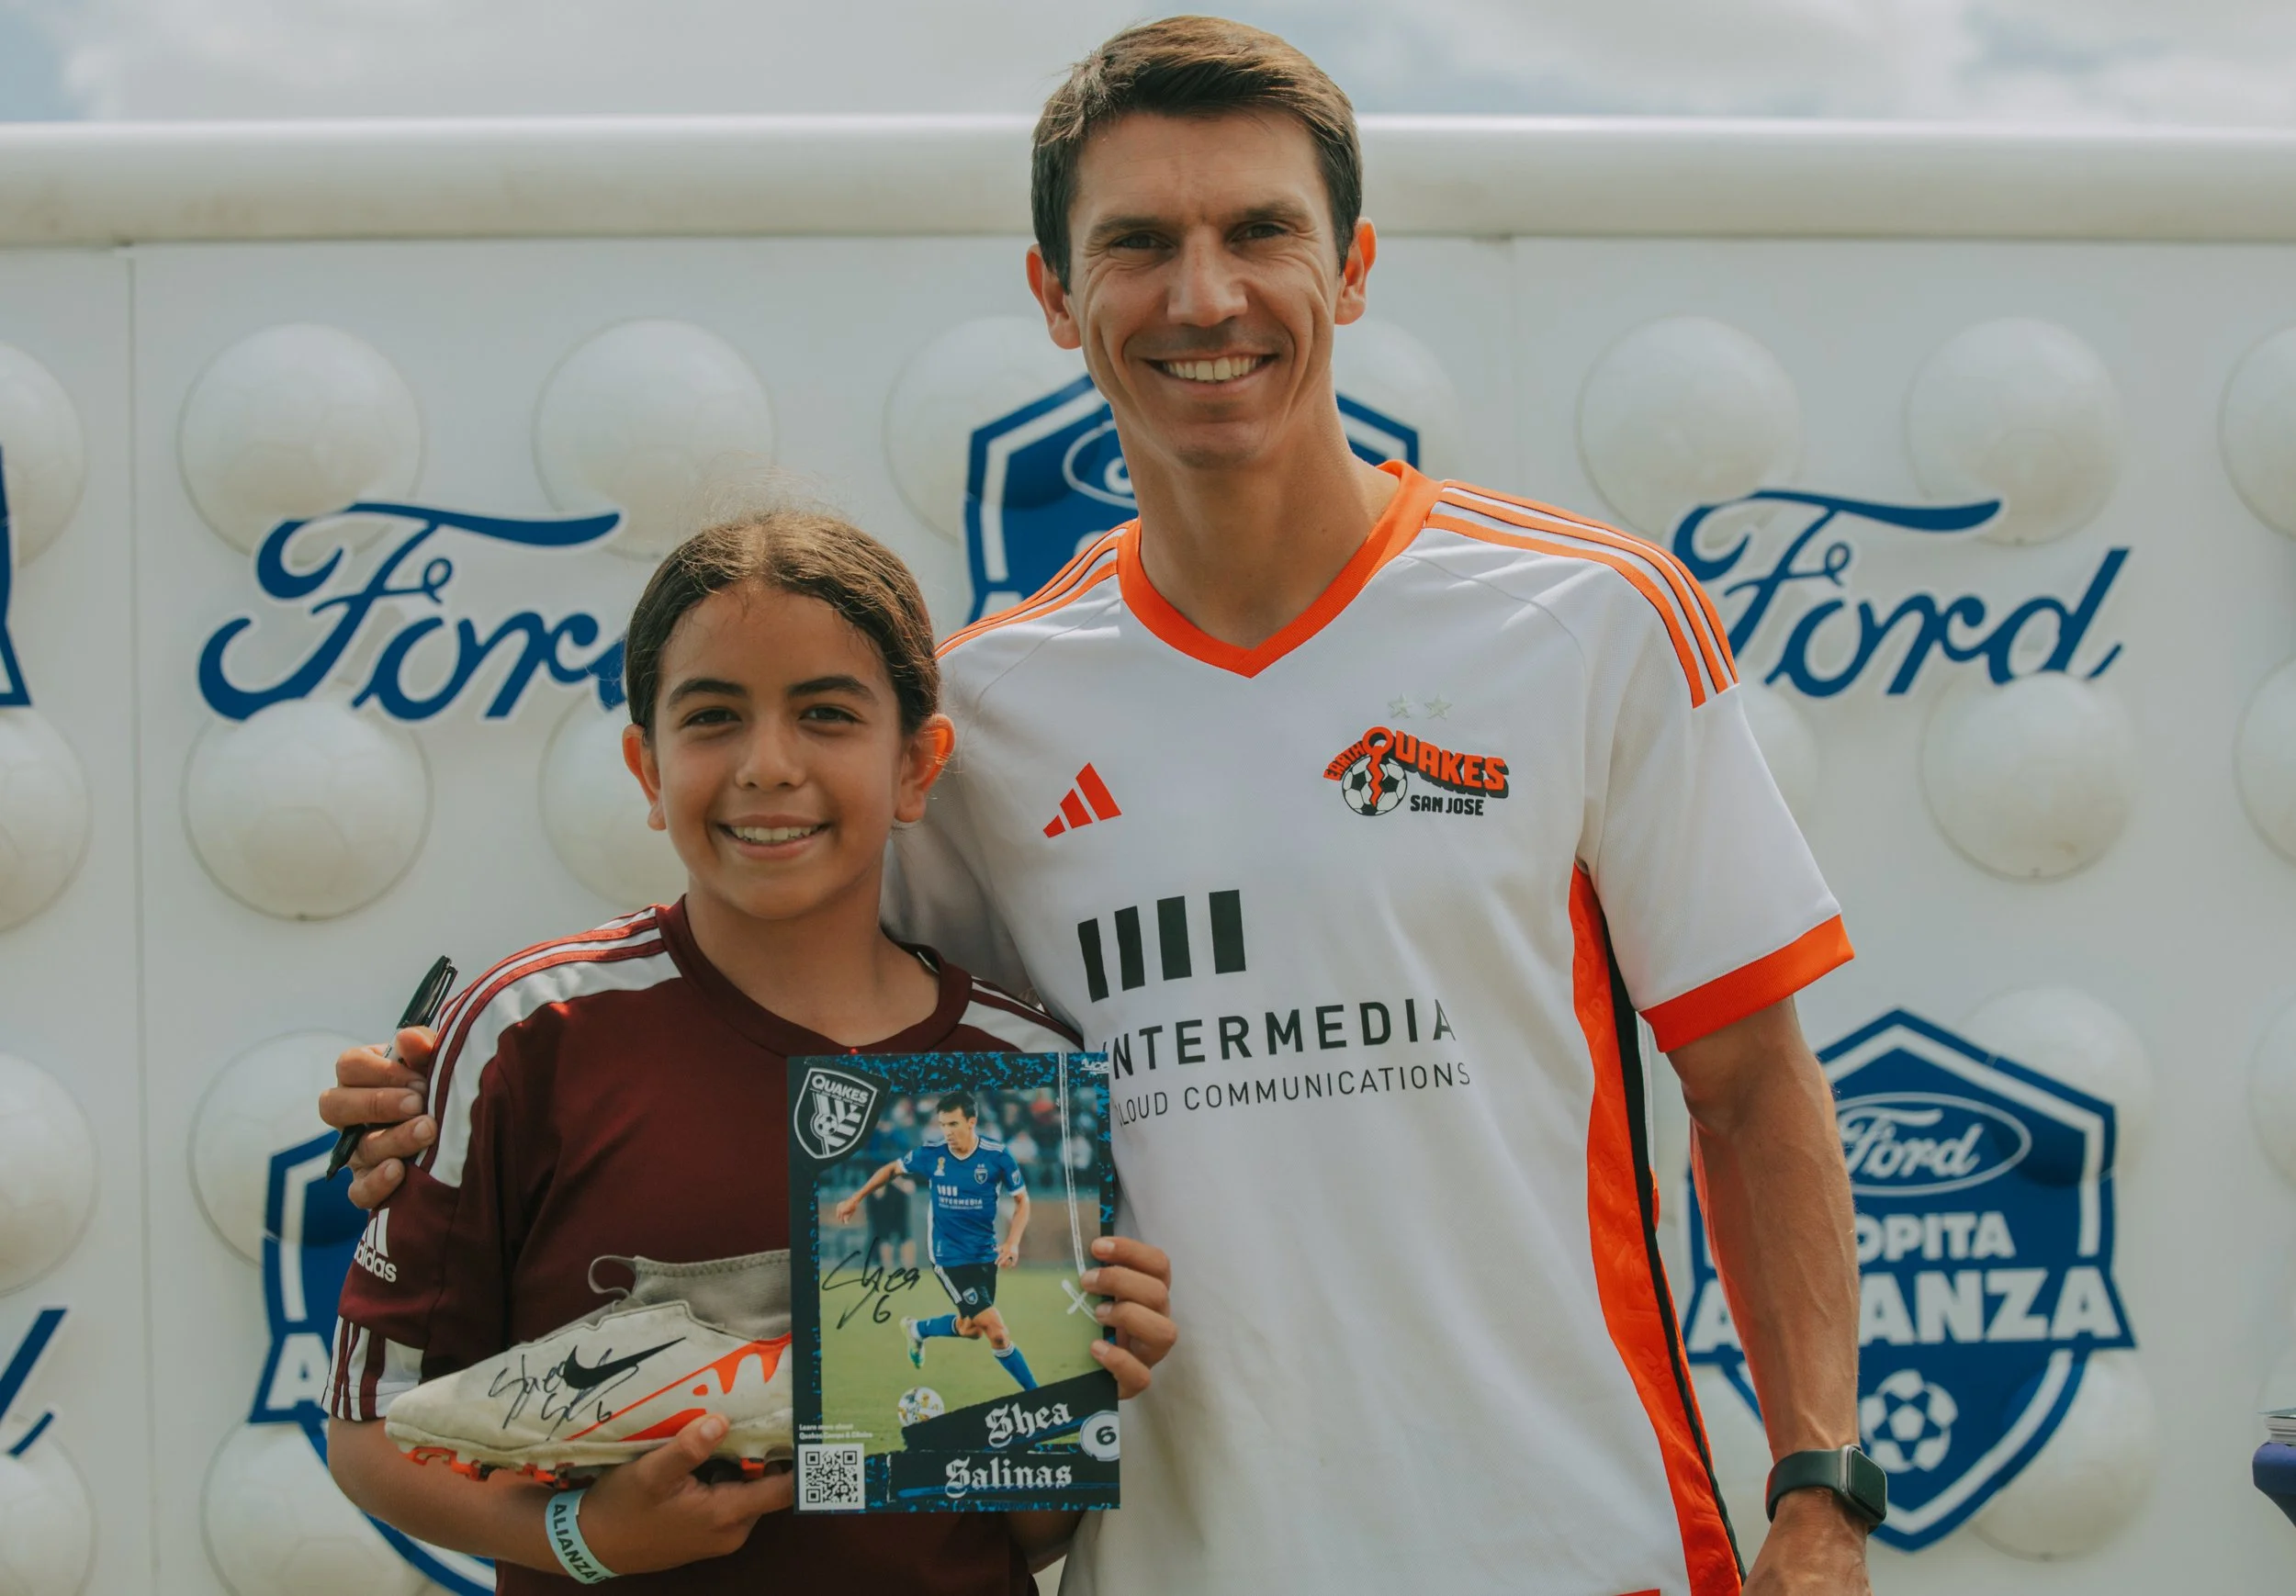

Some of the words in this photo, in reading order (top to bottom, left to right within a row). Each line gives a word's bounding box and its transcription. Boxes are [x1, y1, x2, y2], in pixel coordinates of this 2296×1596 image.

[1671, 489, 2133, 698] Ford
[1410, 794, 1443, 813] SAN
[1446, 798, 1484, 816] JOSE
[1102, 998, 1457, 1080] NTERMEDIA
[811, 1073, 870, 1104] QUAKES
[1184, 1062, 1471, 1111] COMMUNICATIONS
[1838, 1106, 1984, 1179] Ford
[1855, 1209, 2017, 1265] OPITA
[872, 1294, 891, 1324] 6
[1690, 1265, 2121, 1354] AANZA
[985, 1402, 1074, 1448] Shea
[1096, 1425, 1118, 1445] 6
[944, 1456, 1073, 1499] Salinas
[553, 1503, 599, 1579] ALIANZA
